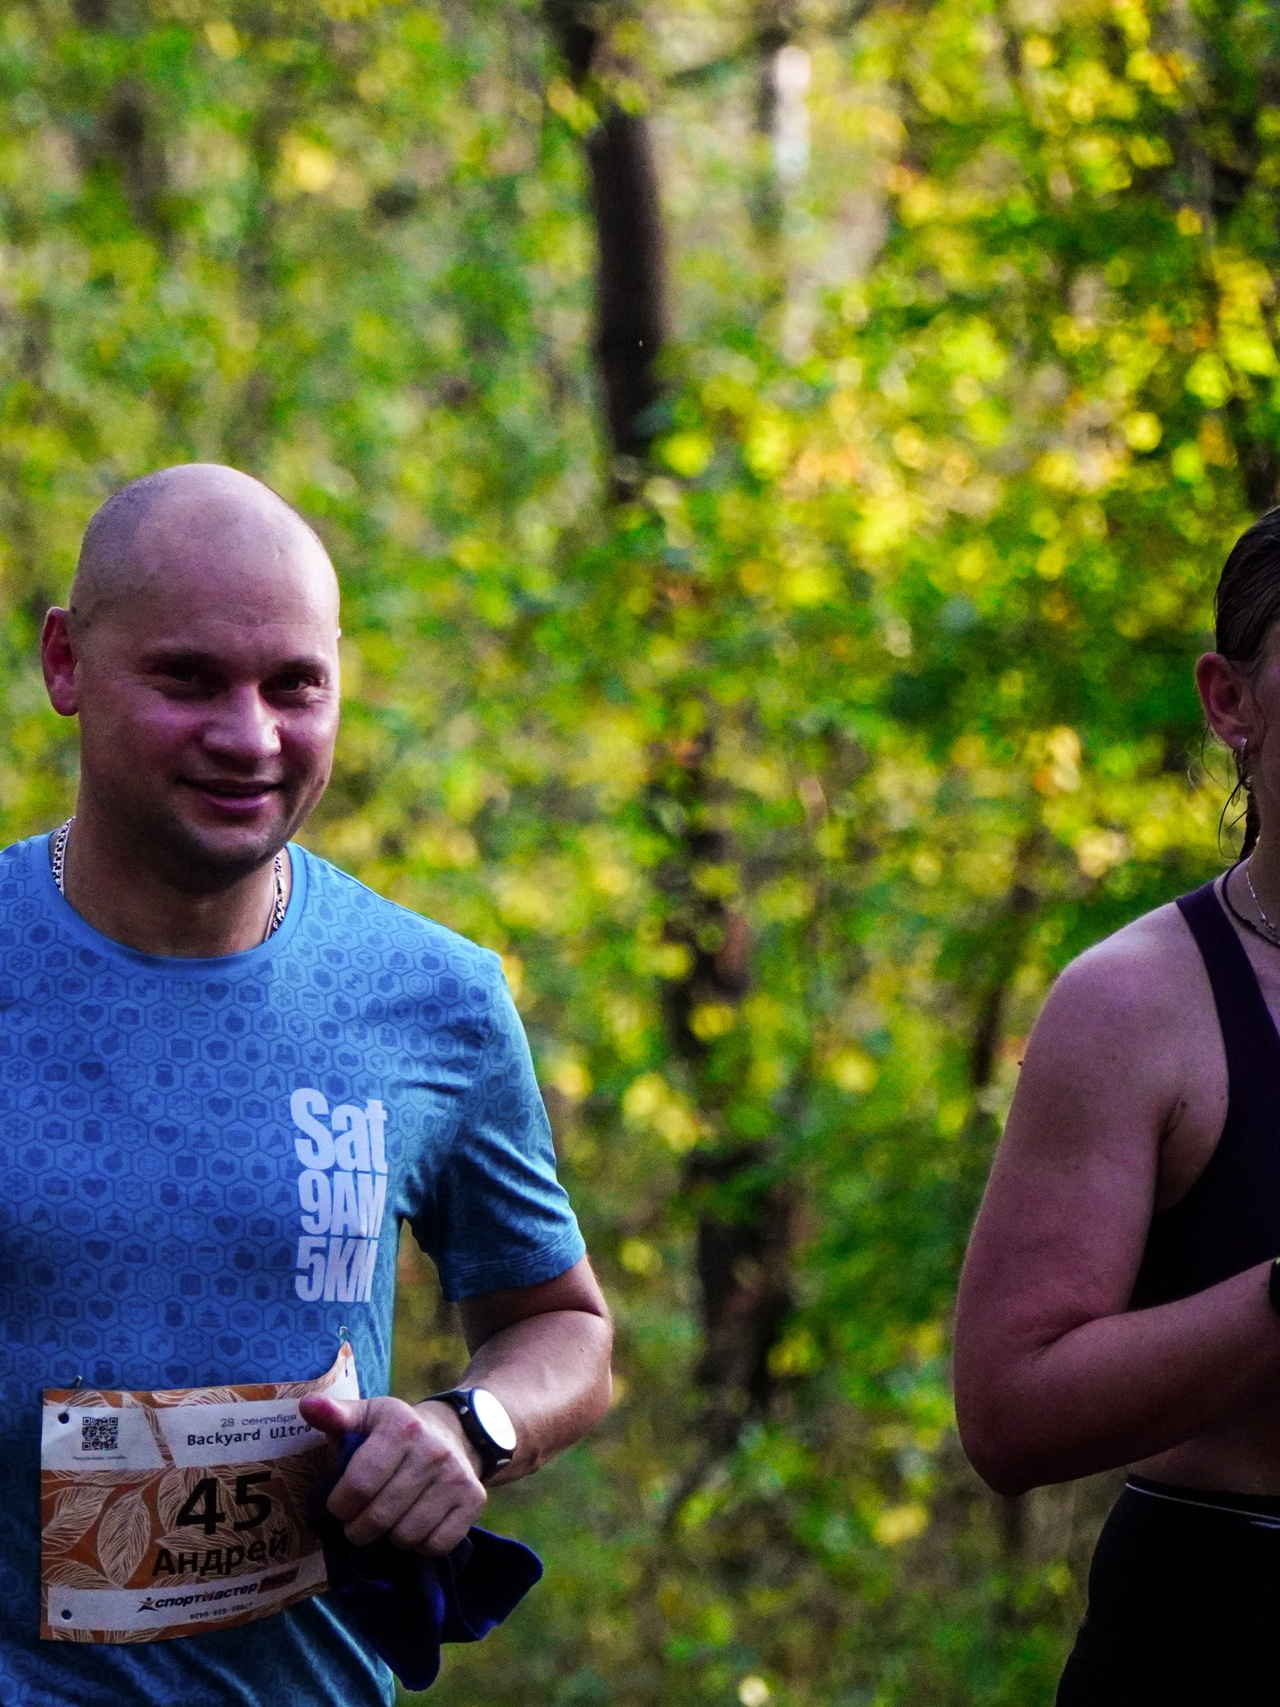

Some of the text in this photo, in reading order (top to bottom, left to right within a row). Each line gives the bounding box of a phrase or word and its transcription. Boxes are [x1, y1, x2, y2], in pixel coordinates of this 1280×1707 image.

[289, 1087, 389, 1174] Sat
[297, 1169, 388, 1239] 9AM
[294, 1235, 379, 1302] 5KM
[187, 1428, 261, 1446] Backyard
[220, 1413, 297, 1428] 28 сентября
[176, 1471, 271, 1535] 45
[151, 1526, 289, 1577] Андрей
